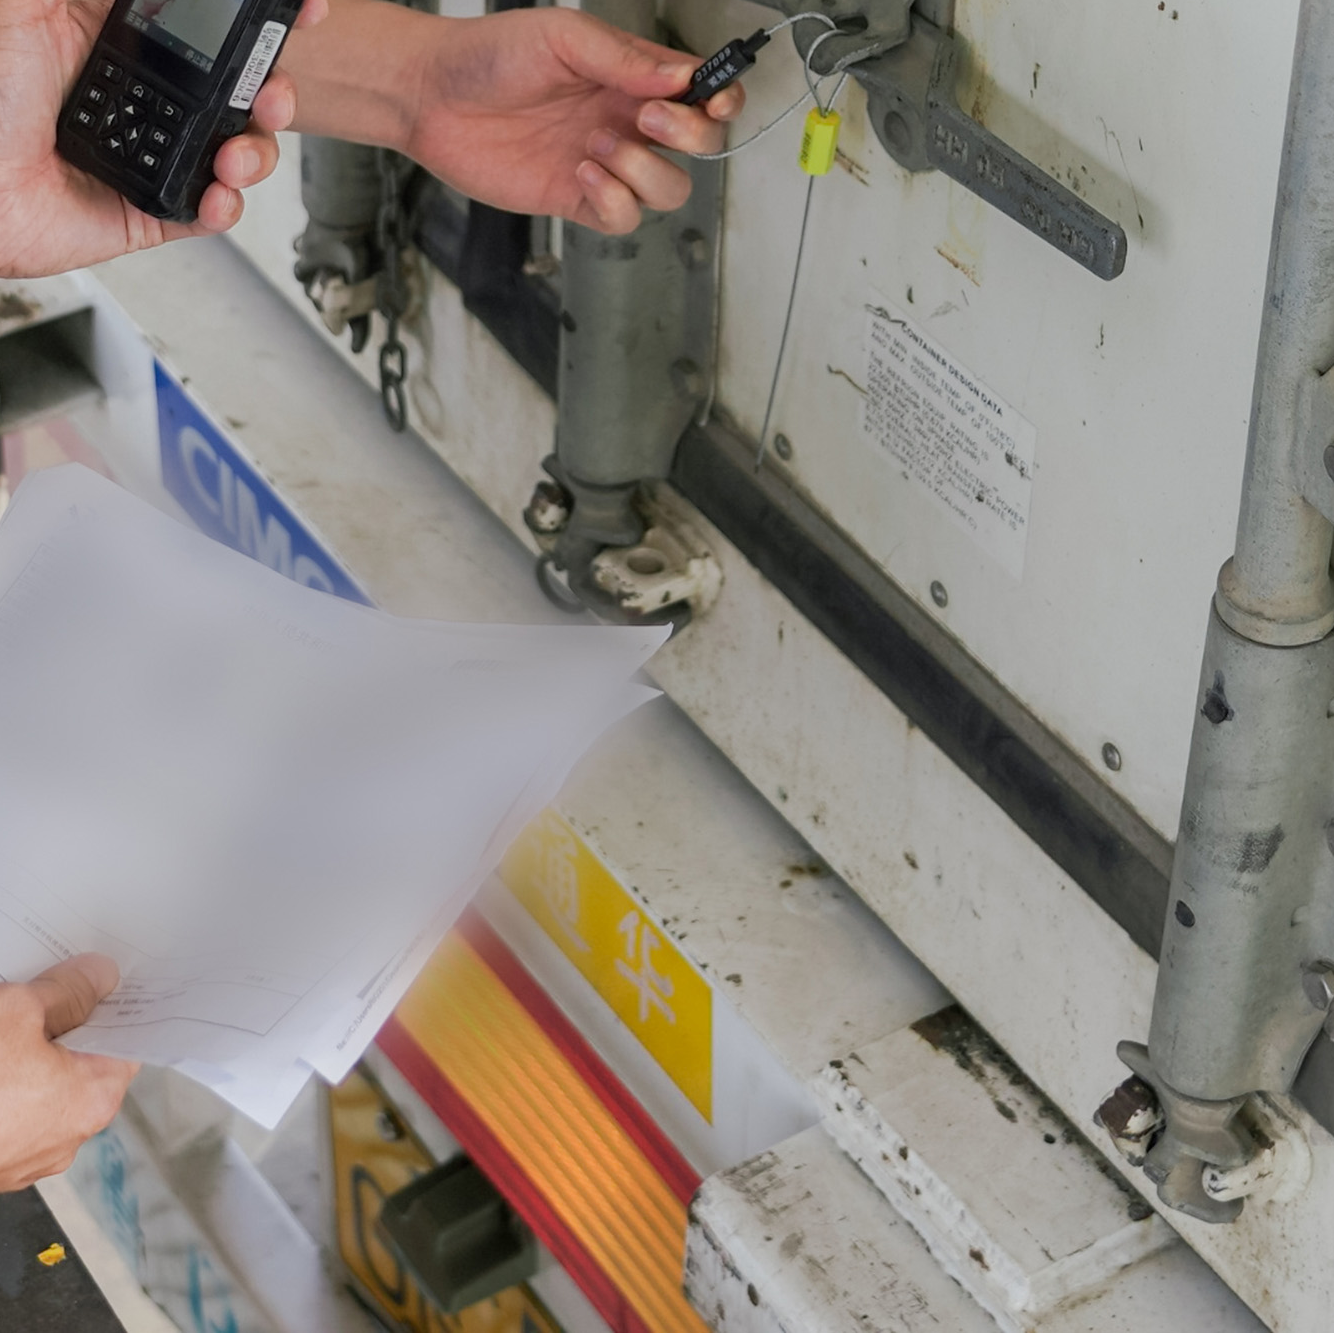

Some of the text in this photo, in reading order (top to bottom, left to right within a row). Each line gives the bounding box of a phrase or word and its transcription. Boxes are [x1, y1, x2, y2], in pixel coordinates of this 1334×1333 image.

[89, 89, 101, 101] M1
[153, 131, 167, 144] OK
[901, 323, 1003, 416] CONTAINER DESIGN DATA
